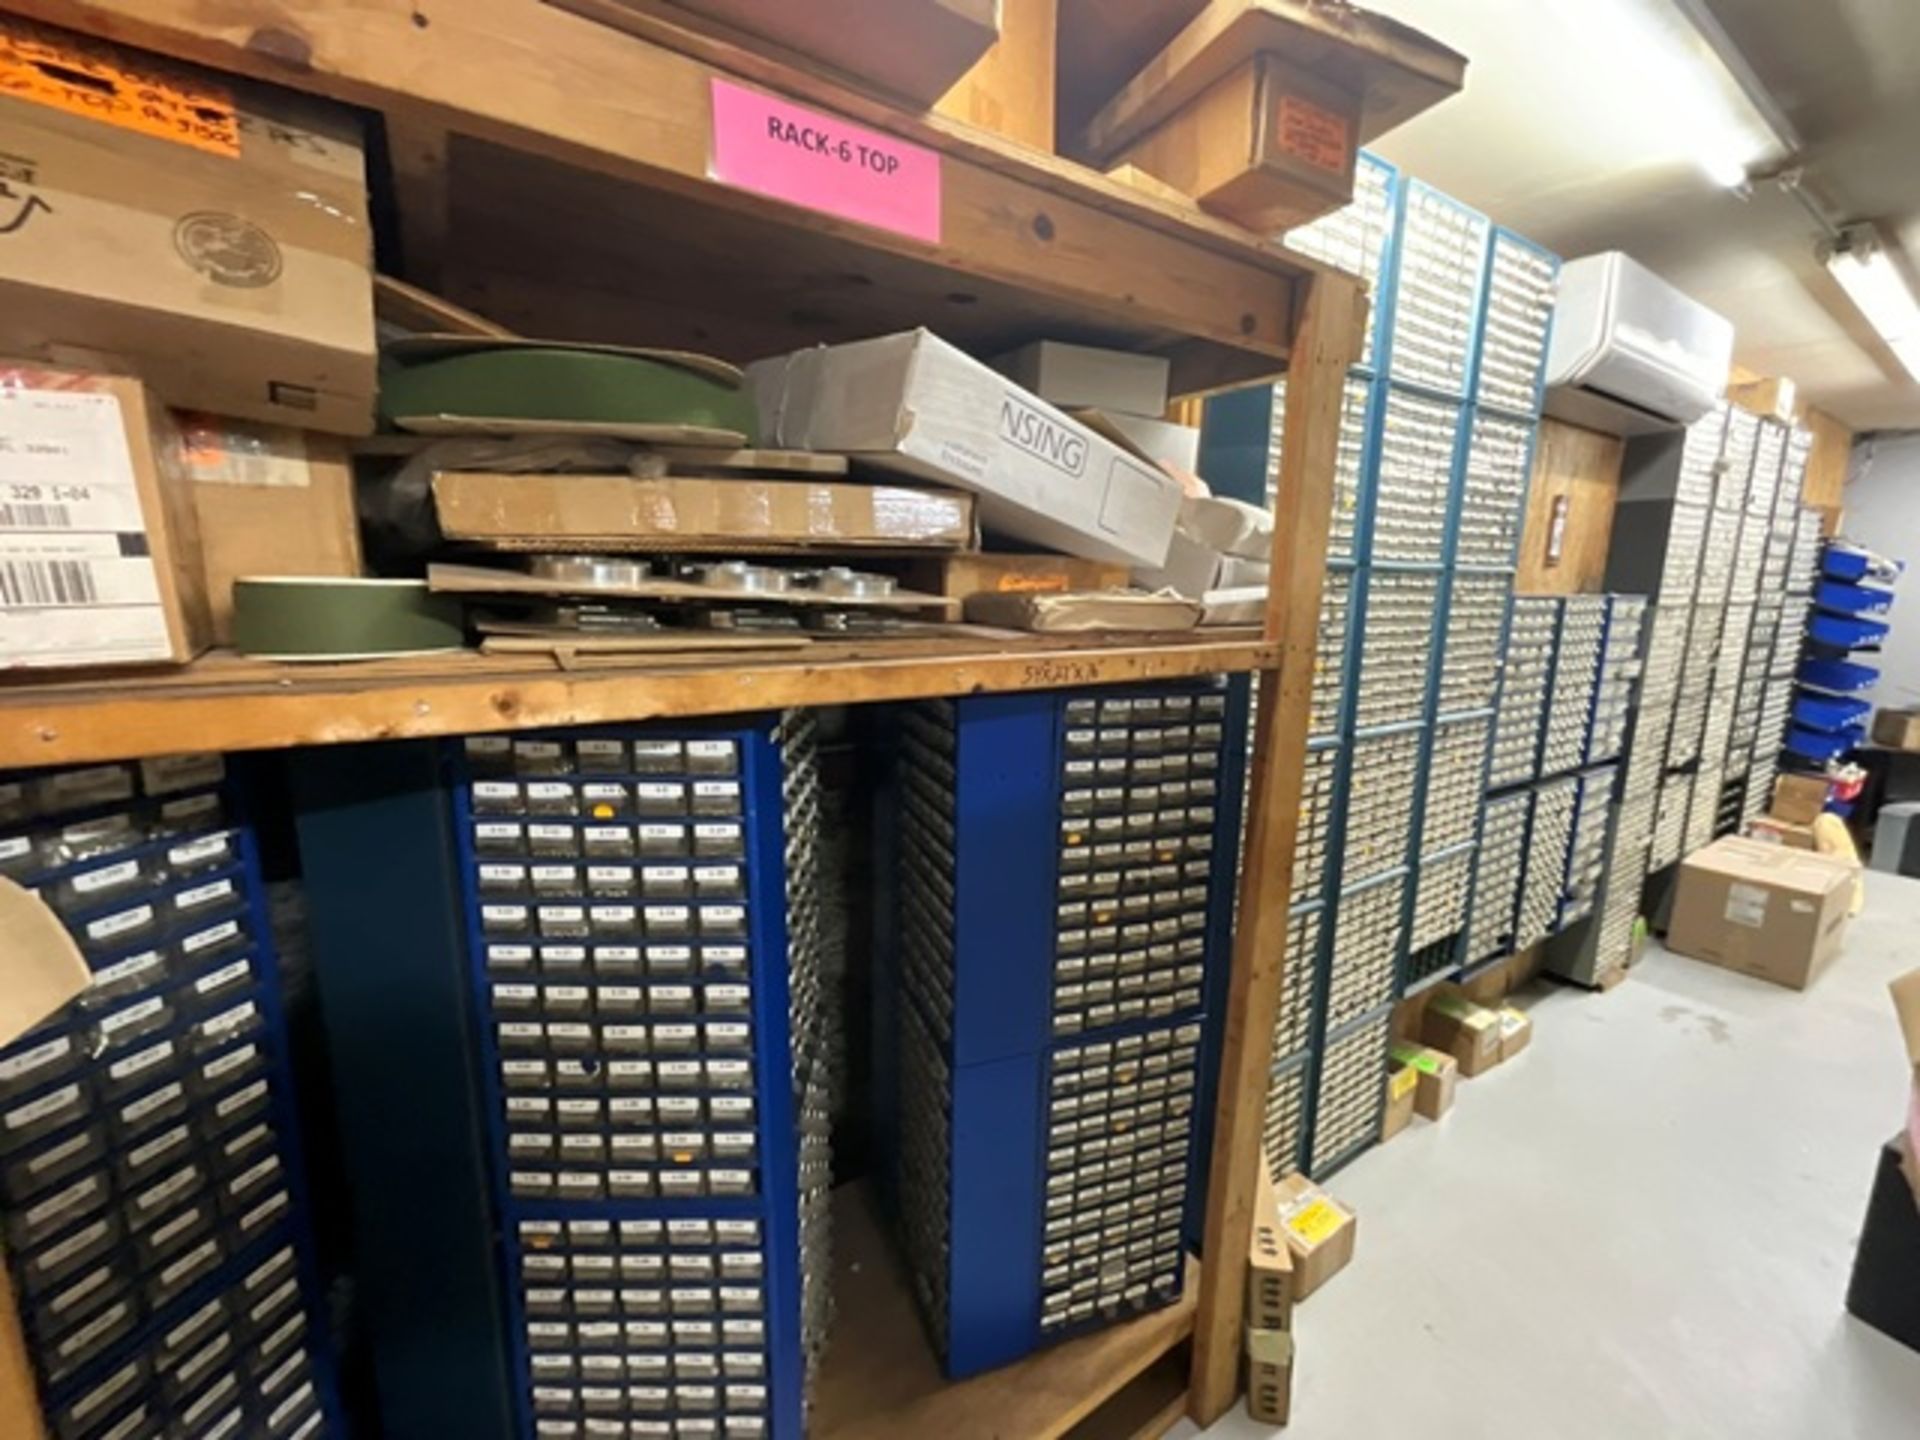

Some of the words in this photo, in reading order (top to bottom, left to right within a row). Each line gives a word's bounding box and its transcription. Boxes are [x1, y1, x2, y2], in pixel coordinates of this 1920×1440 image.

[767, 116, 853, 163] RACK-6
[856, 144, 899, 175] TOP
[1001, 401, 1082, 469] NSING
